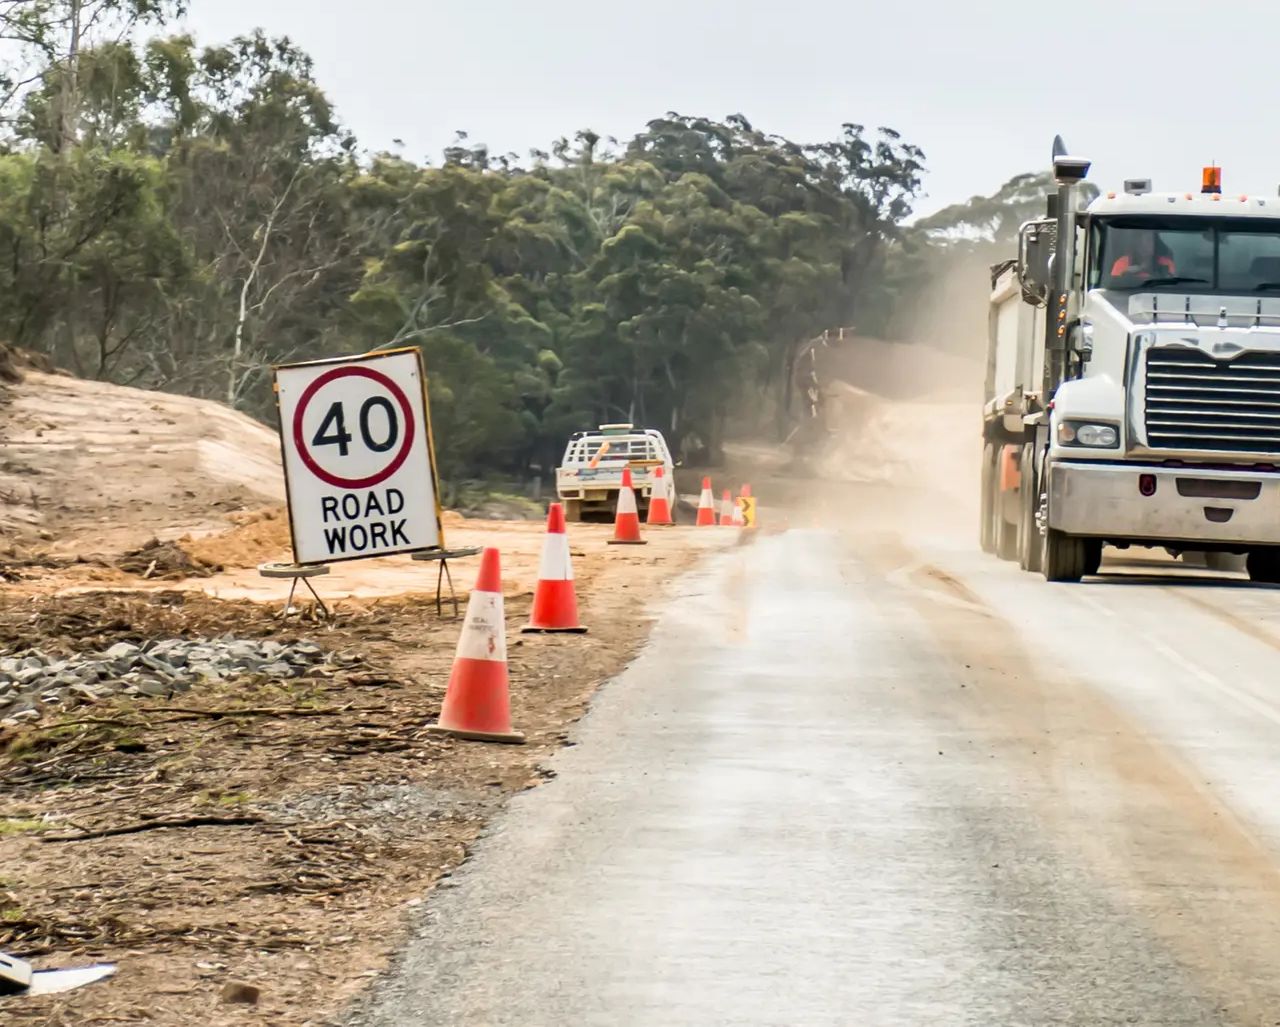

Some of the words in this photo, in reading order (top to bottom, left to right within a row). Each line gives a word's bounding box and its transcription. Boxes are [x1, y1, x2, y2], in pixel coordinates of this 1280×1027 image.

[311, 395, 399, 457] 40
[321, 488, 405, 523] ROAD
[323, 518, 411, 555] WORK
